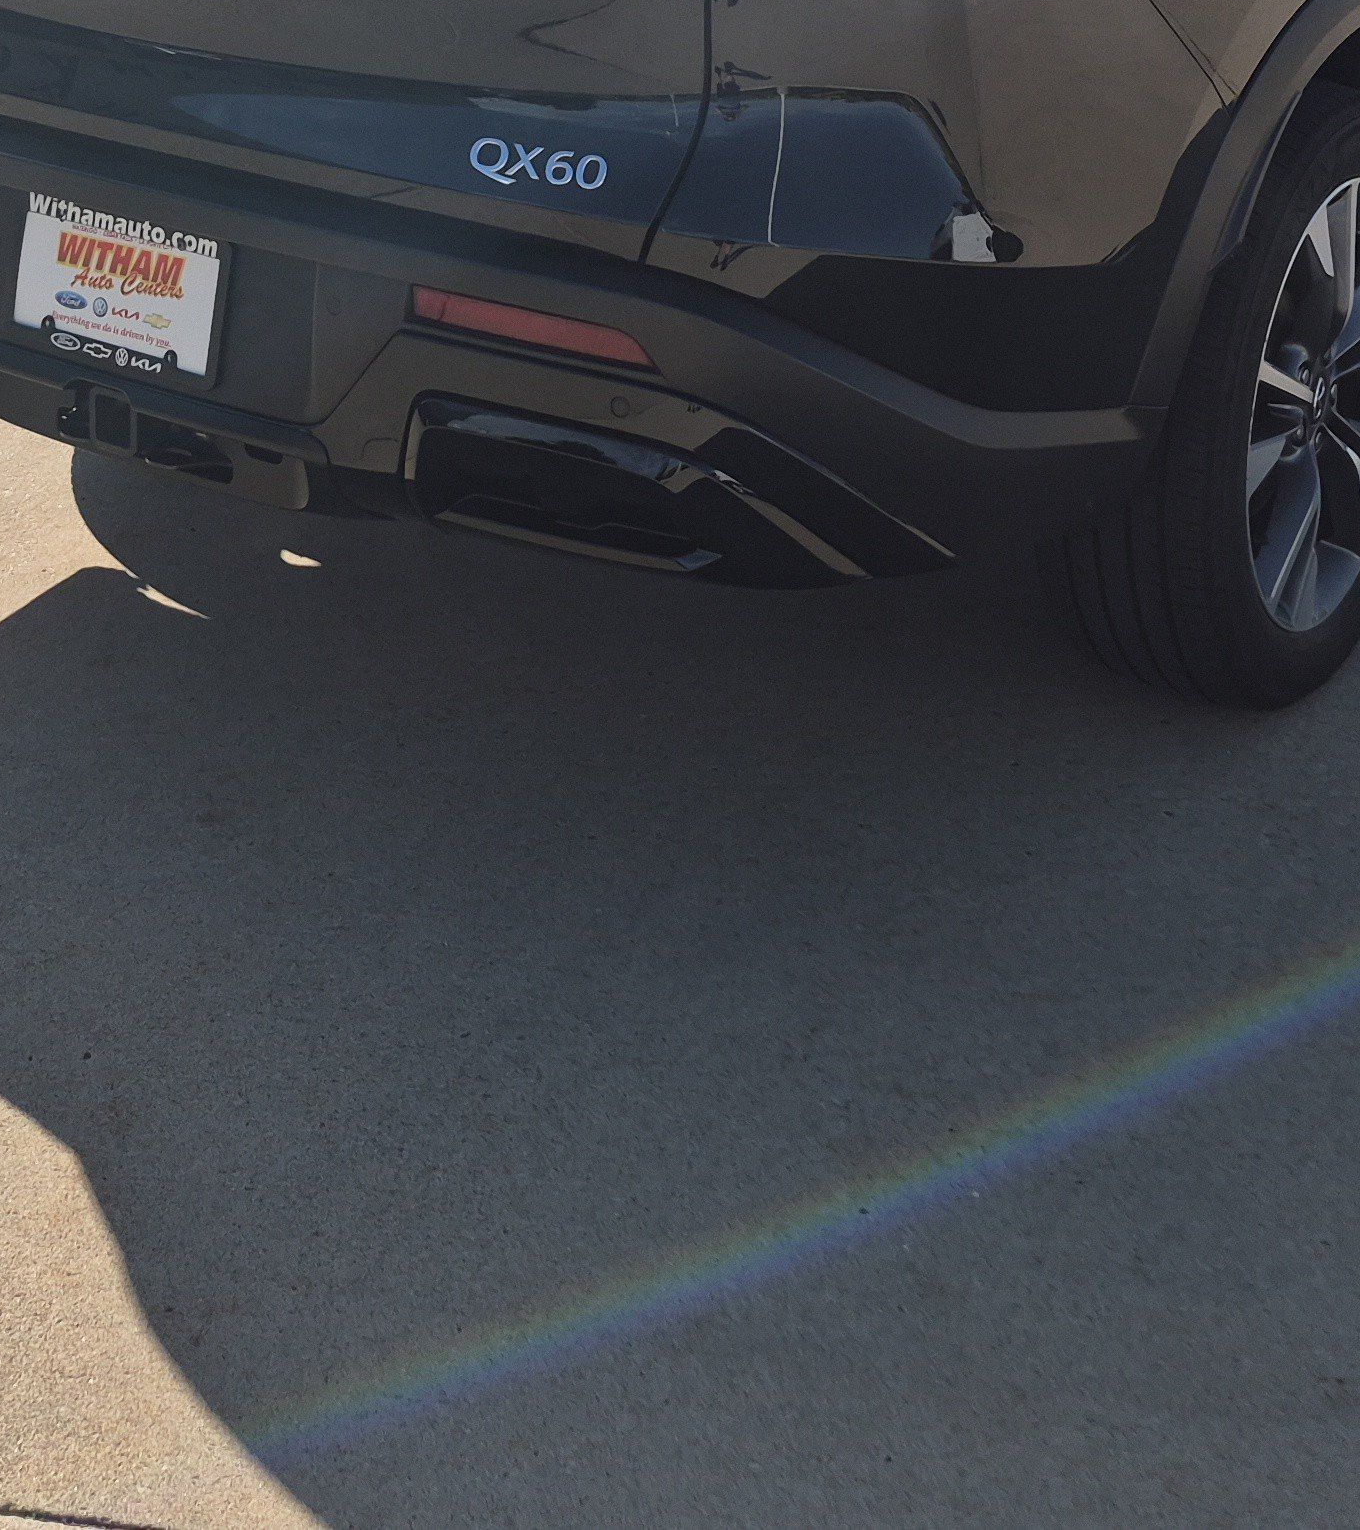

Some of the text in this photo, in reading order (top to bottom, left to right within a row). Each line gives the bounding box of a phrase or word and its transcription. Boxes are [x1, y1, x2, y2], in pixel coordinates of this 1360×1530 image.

[470, 137, 607, 189] QX60
[29, 192, 218, 258] Withamauto.com
[57, 232, 187, 286] WITHAM
[71, 268, 184, 299] Auto Centers
[52, 310, 91, 329] Everything
